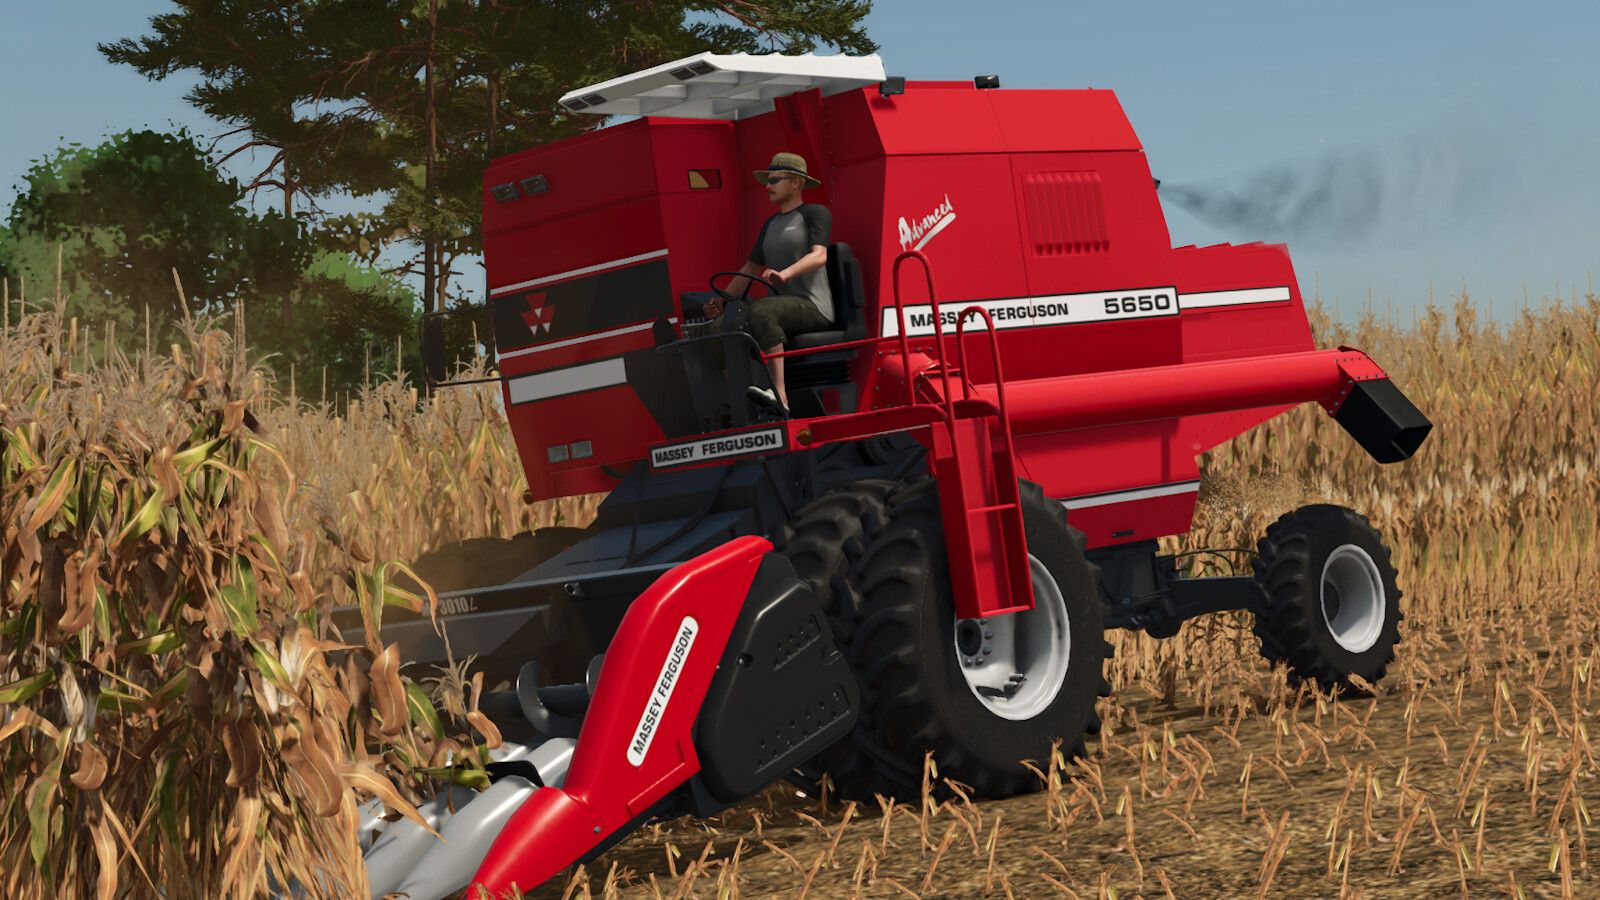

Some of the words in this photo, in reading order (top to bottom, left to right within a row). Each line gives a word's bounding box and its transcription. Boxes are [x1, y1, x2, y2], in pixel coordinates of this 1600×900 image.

[898, 192, 954, 252] Advanced
[988, 303, 1069, 321] FERGUSON
[1104, 294, 1170, 314] 5650
[655, 446, 694, 464] MASSEY
[702, 433, 776, 455] FERGUSON
[633, 697, 662, 755] MASSEY
[657, 625, 693, 697] FERGUSON
